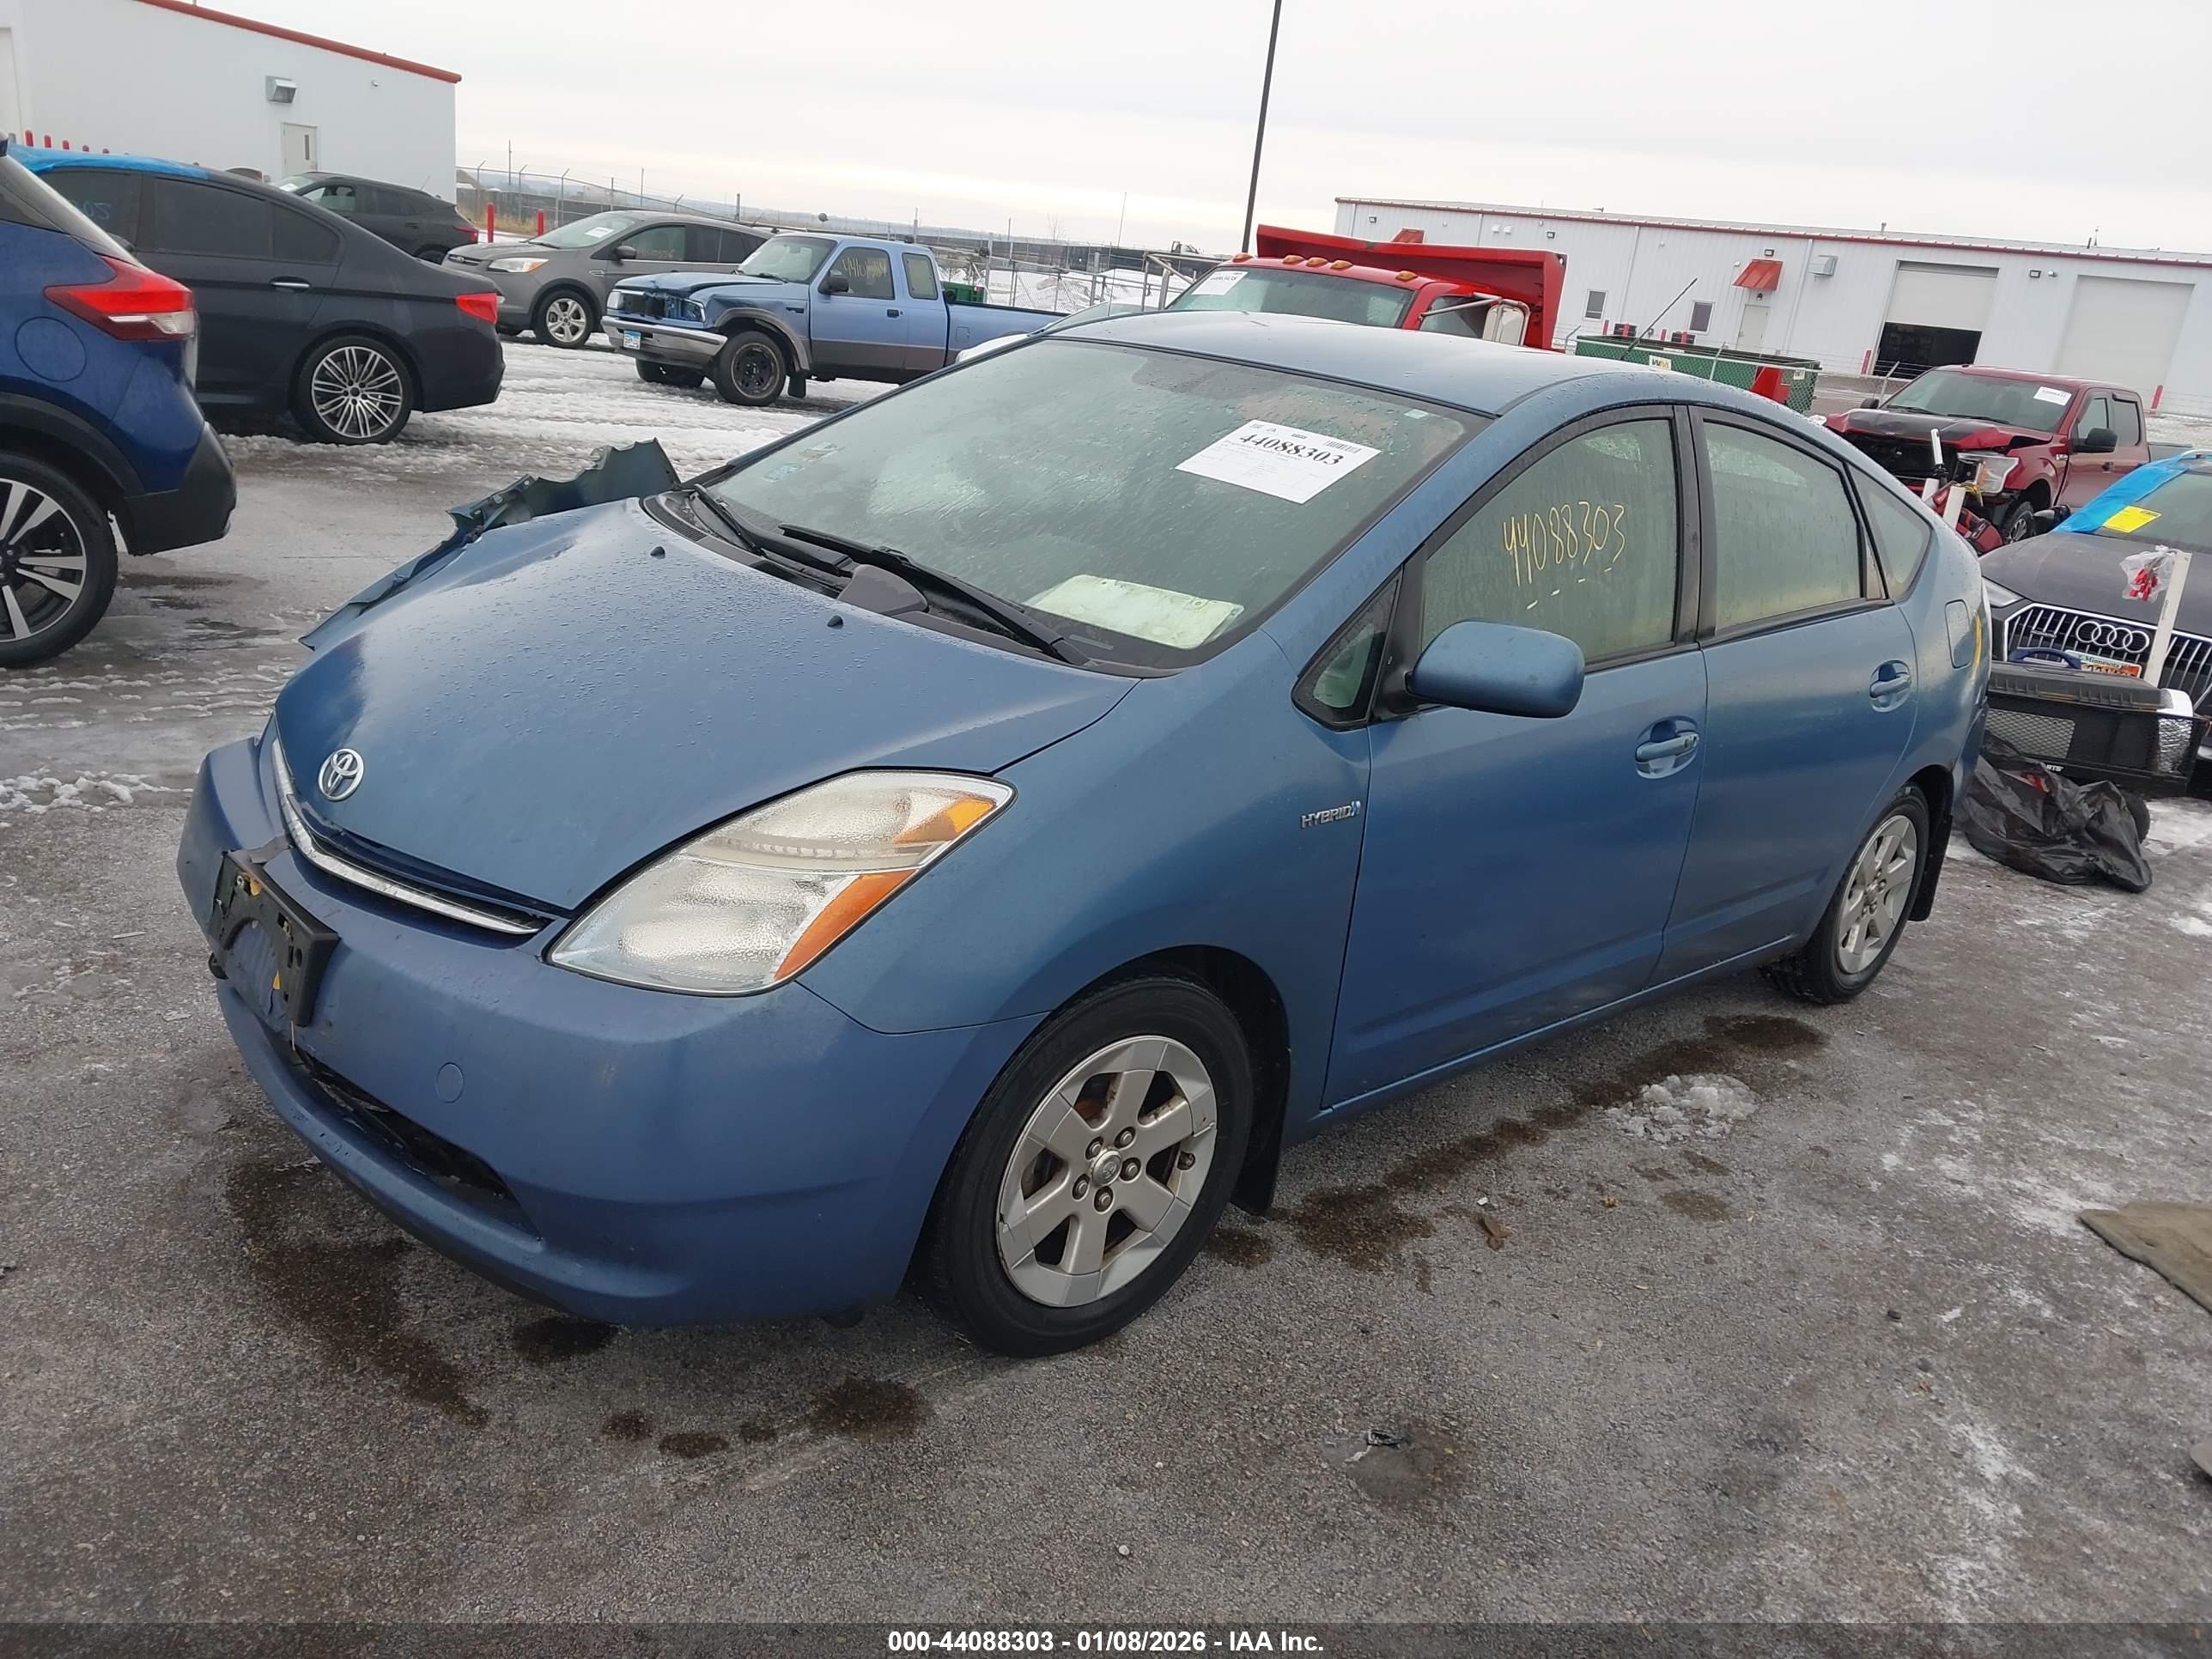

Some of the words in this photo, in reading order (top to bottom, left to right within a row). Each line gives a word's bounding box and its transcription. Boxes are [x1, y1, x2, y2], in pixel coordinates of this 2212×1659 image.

[1240, 434, 1345, 465] 44088303
[1504, 501, 1626, 587] 44088303
[1301, 805, 1352, 829] HYBRID
